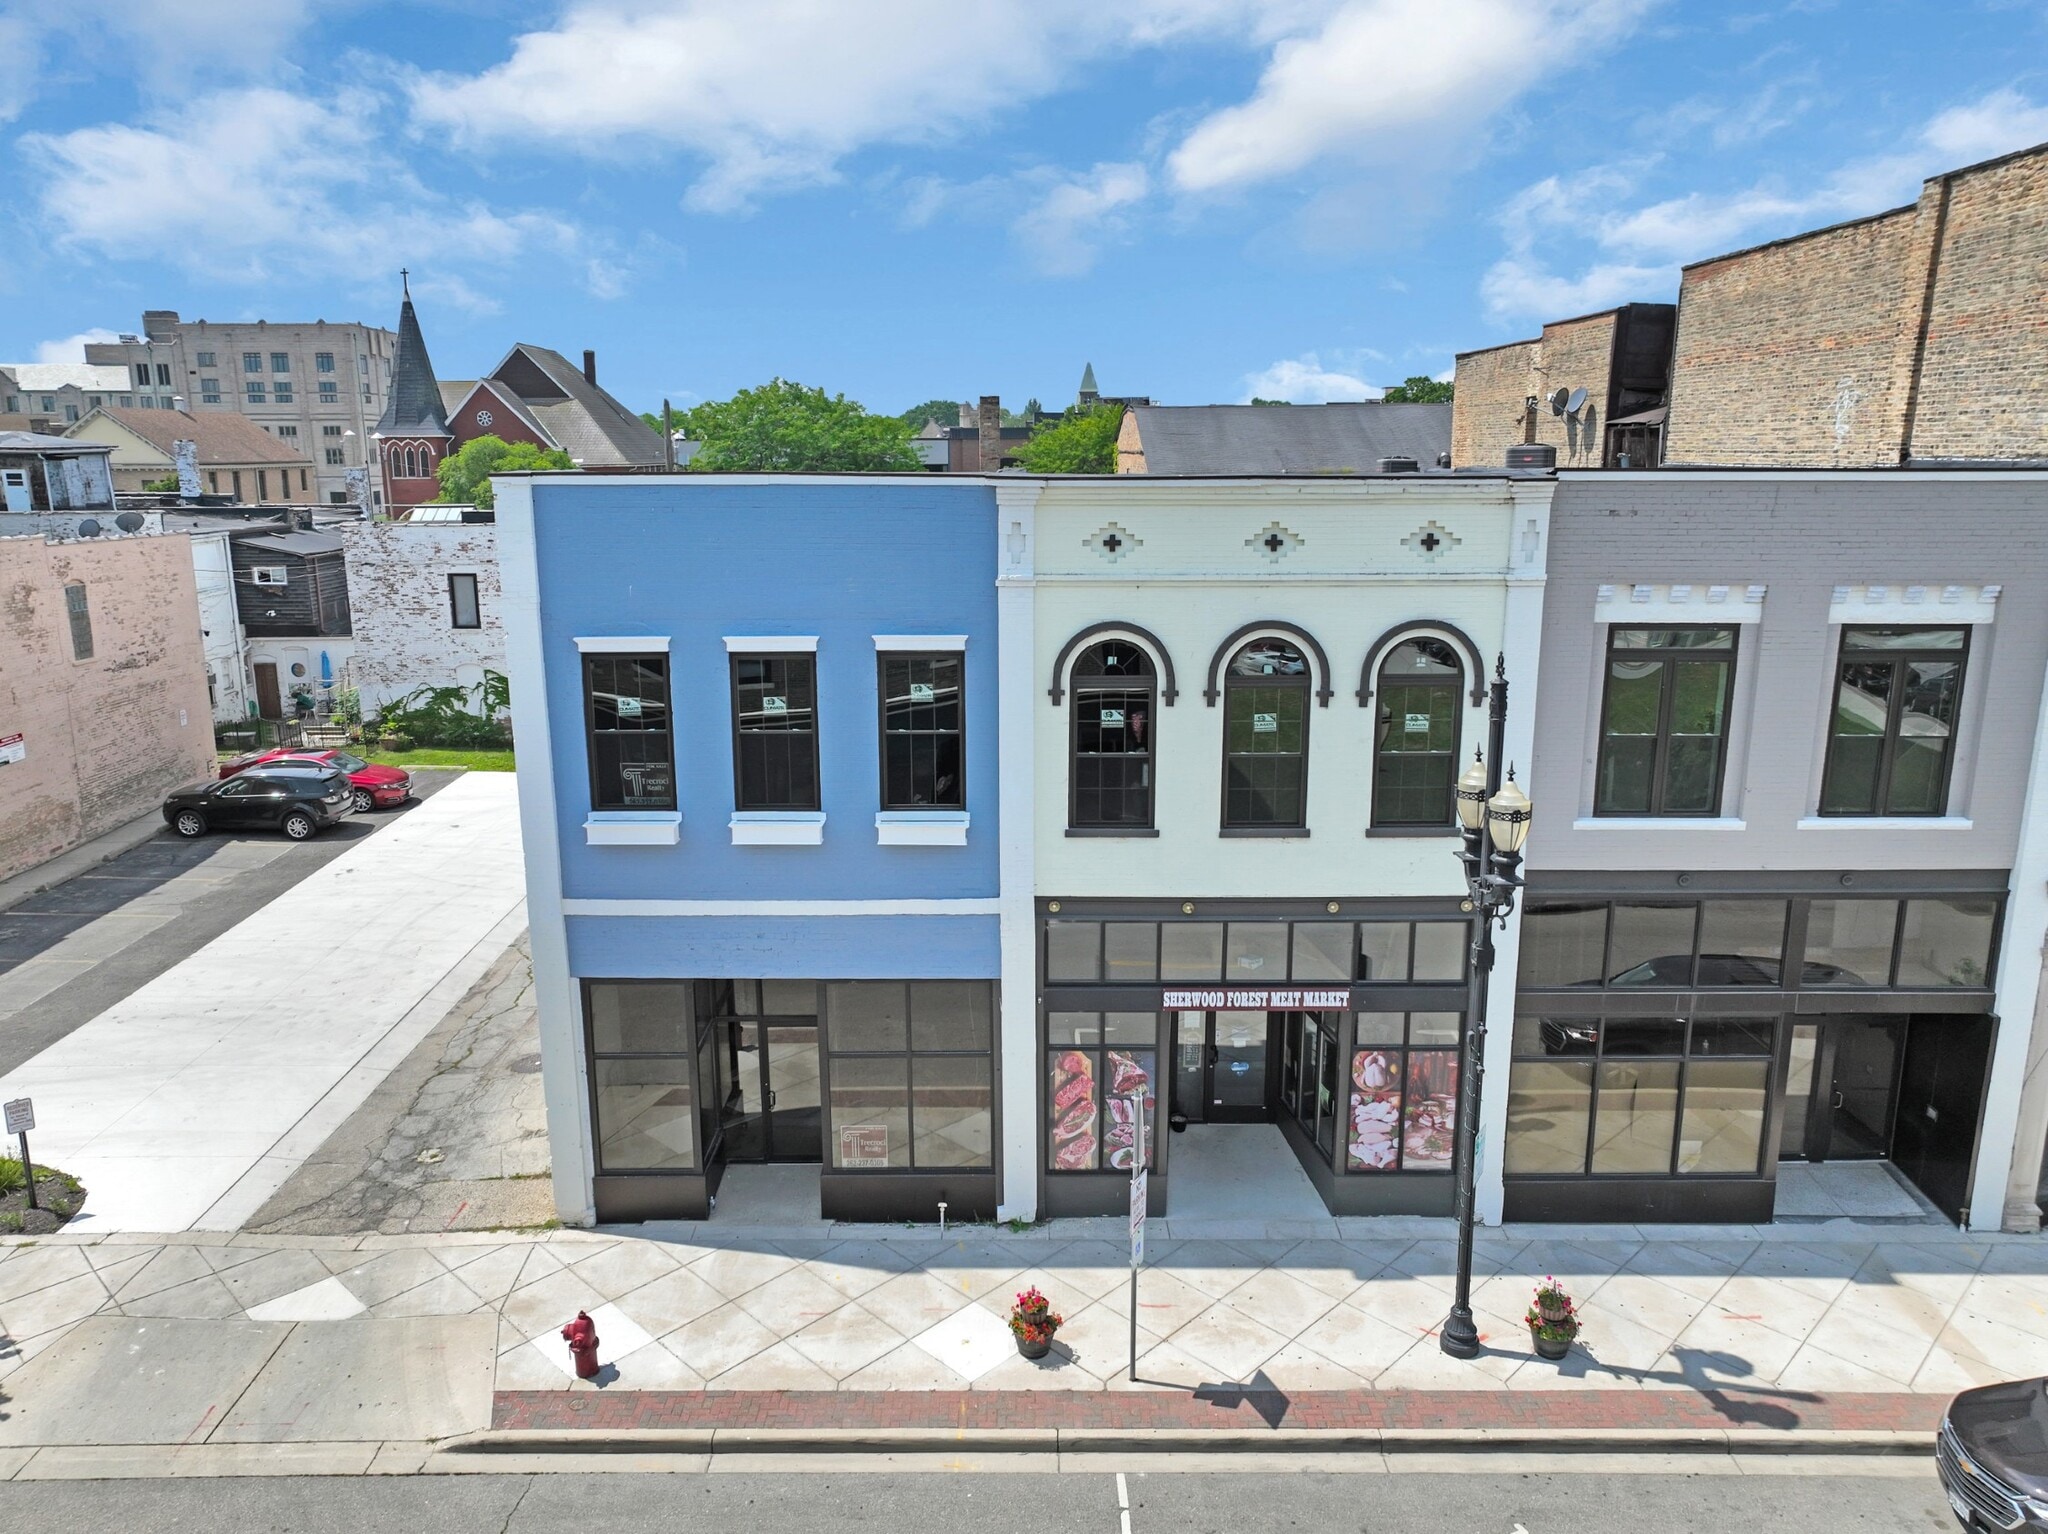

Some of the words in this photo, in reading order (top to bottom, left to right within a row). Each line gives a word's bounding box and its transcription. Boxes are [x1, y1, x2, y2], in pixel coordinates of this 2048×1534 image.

[1163, 991, 1225, 1008] SHERWOOD
[1226, 991, 1269, 1008] FOREST
[1270, 991, 1301, 1008] MEAT
[1303, 991, 1350, 1008] MARKET
